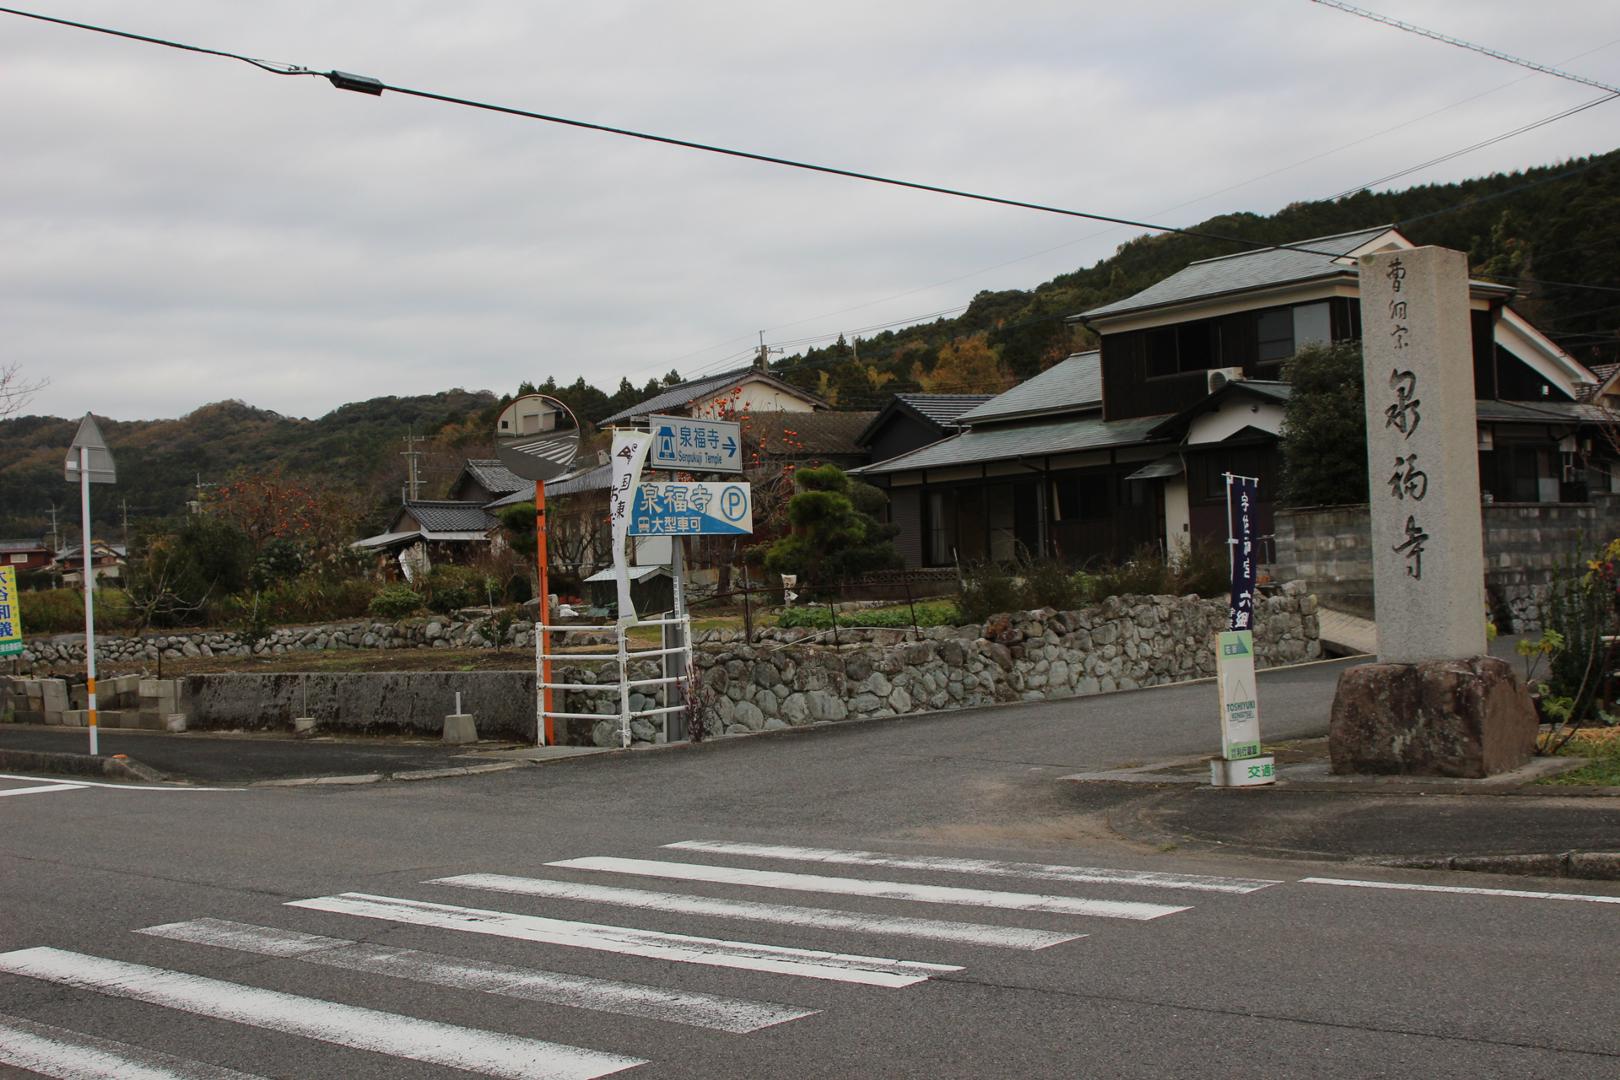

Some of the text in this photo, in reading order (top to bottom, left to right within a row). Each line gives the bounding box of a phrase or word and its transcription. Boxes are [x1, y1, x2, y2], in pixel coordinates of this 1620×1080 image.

[1385, 257, 1408, 350] 曹洞宗
[679, 425, 720, 450] 泉福寺
[1385, 367, 1430, 582] 泉福寺
[640, 483, 713, 514] 泉福寺
[651, 516, 702, 533] 大型車可
